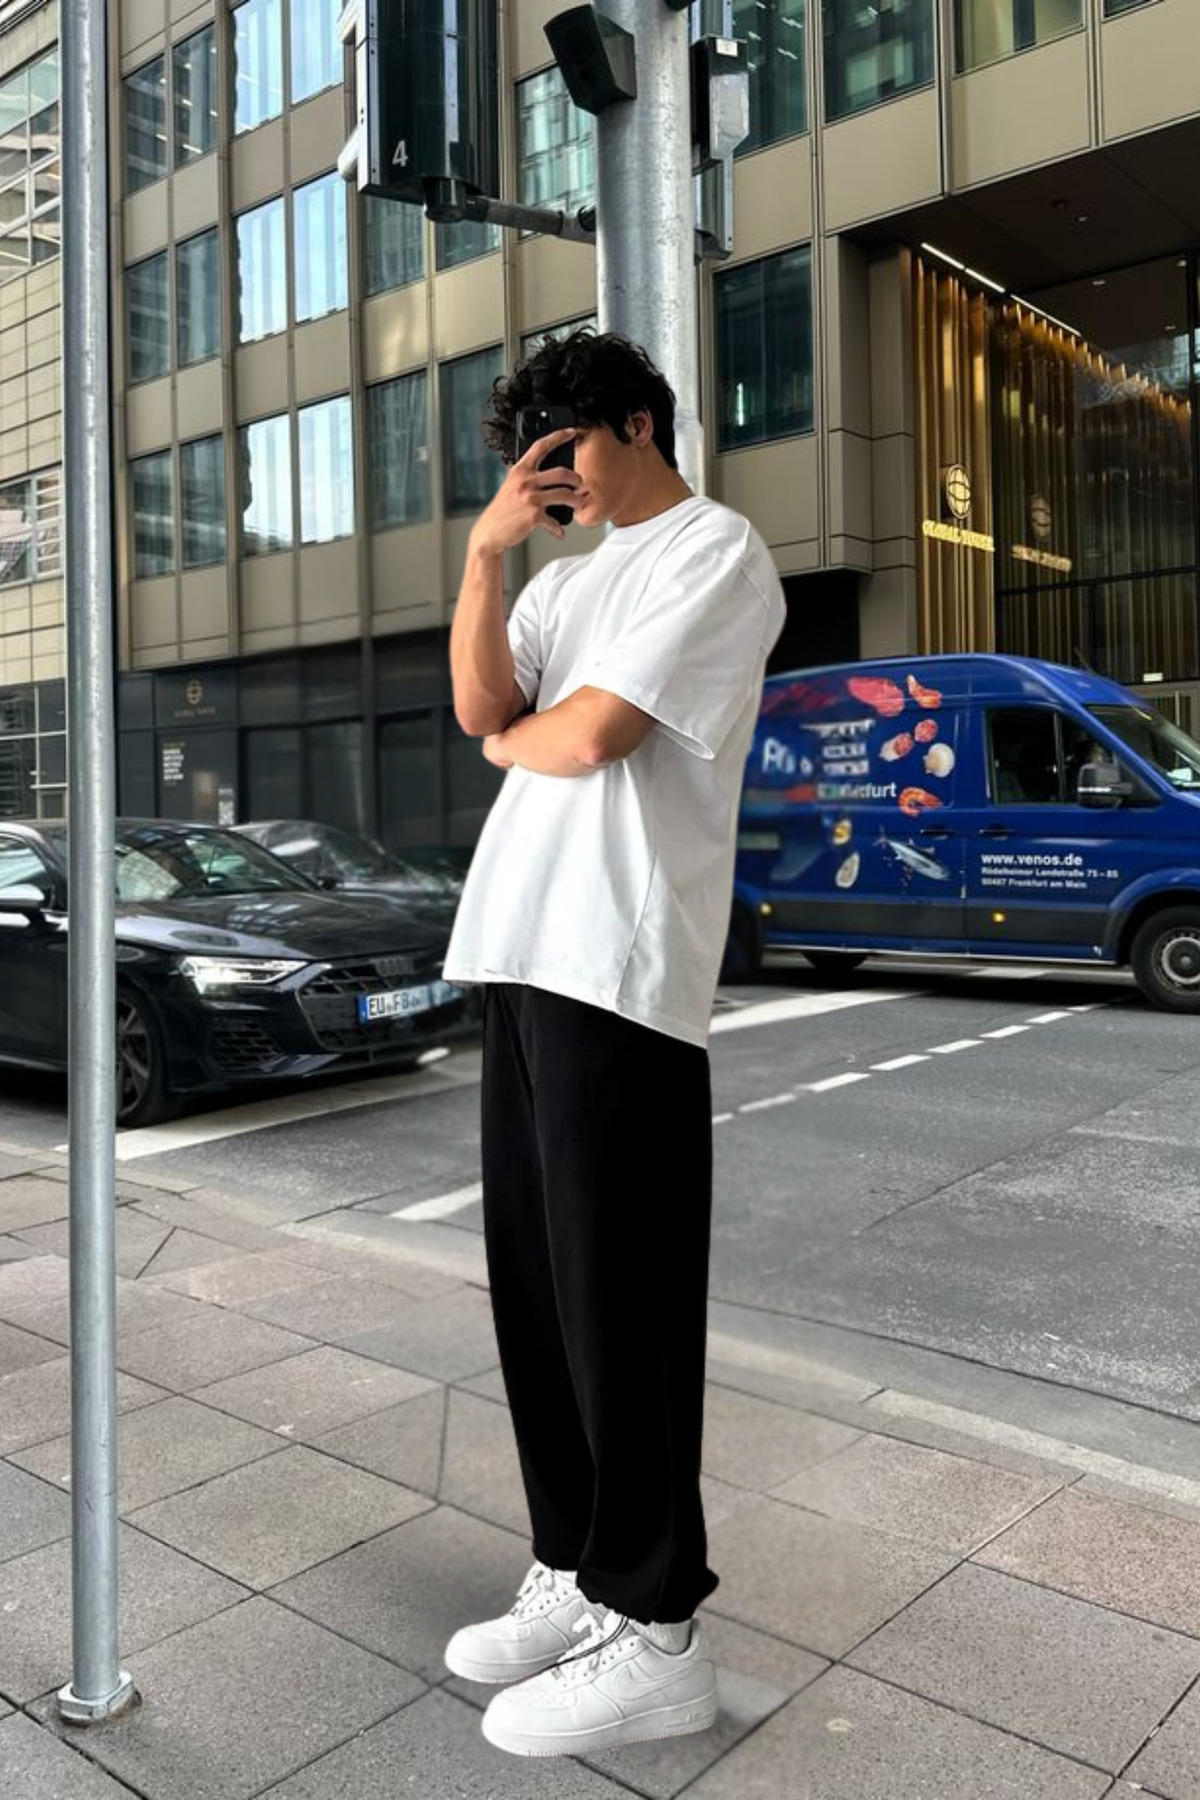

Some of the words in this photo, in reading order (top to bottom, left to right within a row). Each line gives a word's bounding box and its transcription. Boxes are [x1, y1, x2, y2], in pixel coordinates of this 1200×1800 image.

[392, 140, 409, 167] 4
[981, 853, 1083, 866] www.venos.de
[1008, 879, 1048, 888] Frankfurt
[1065, 880, 1087, 889] Main
